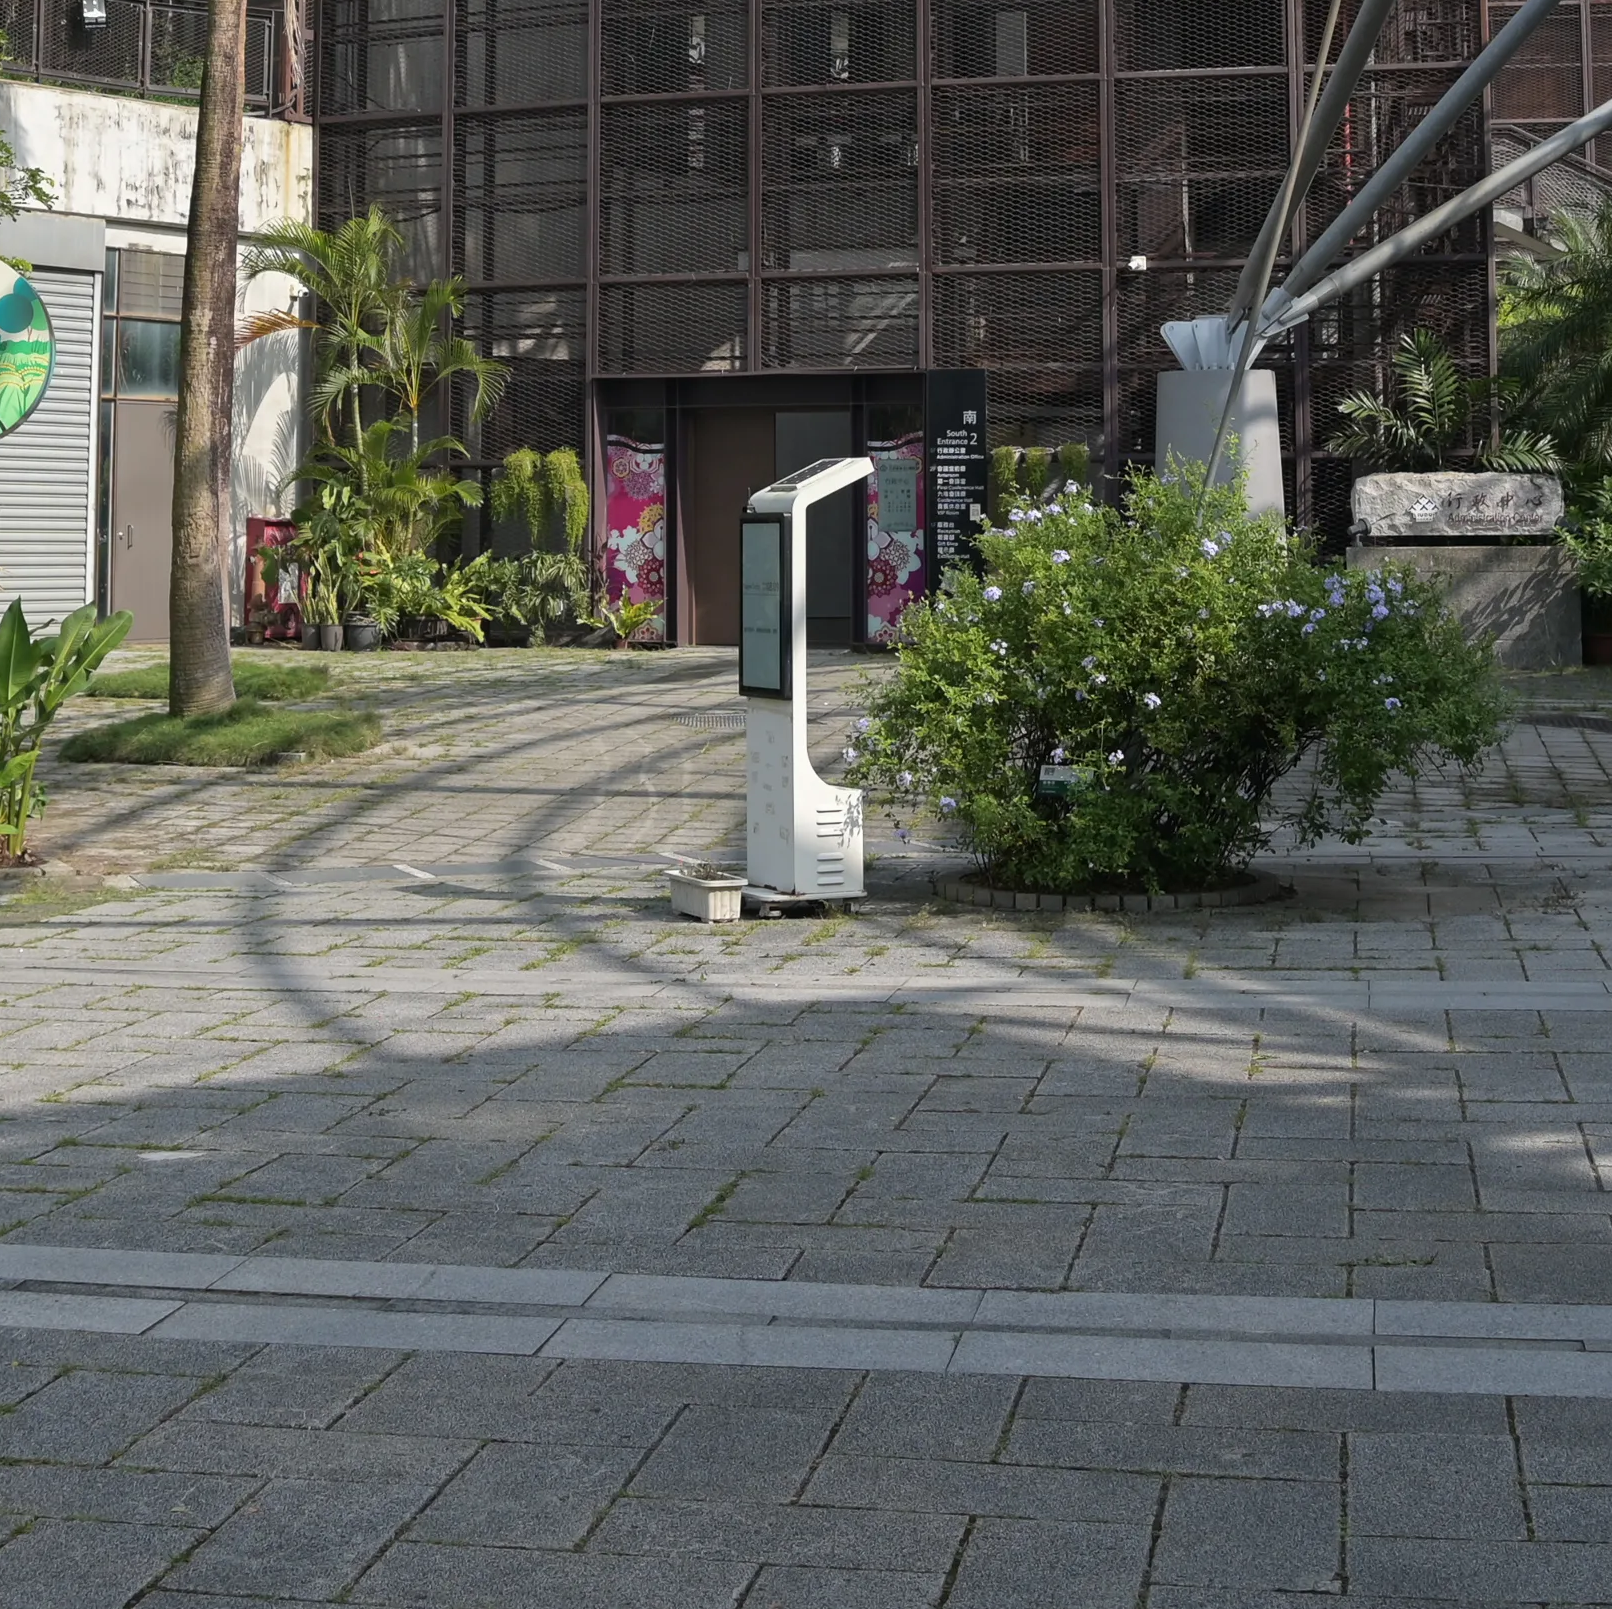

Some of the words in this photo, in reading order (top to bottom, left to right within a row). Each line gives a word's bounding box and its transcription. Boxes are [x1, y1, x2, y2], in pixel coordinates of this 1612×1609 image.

[962, 410, 977, 425] 南
[969, 432, 978, 445] 2
[1442, 491, 1544, 510] 行政中心
